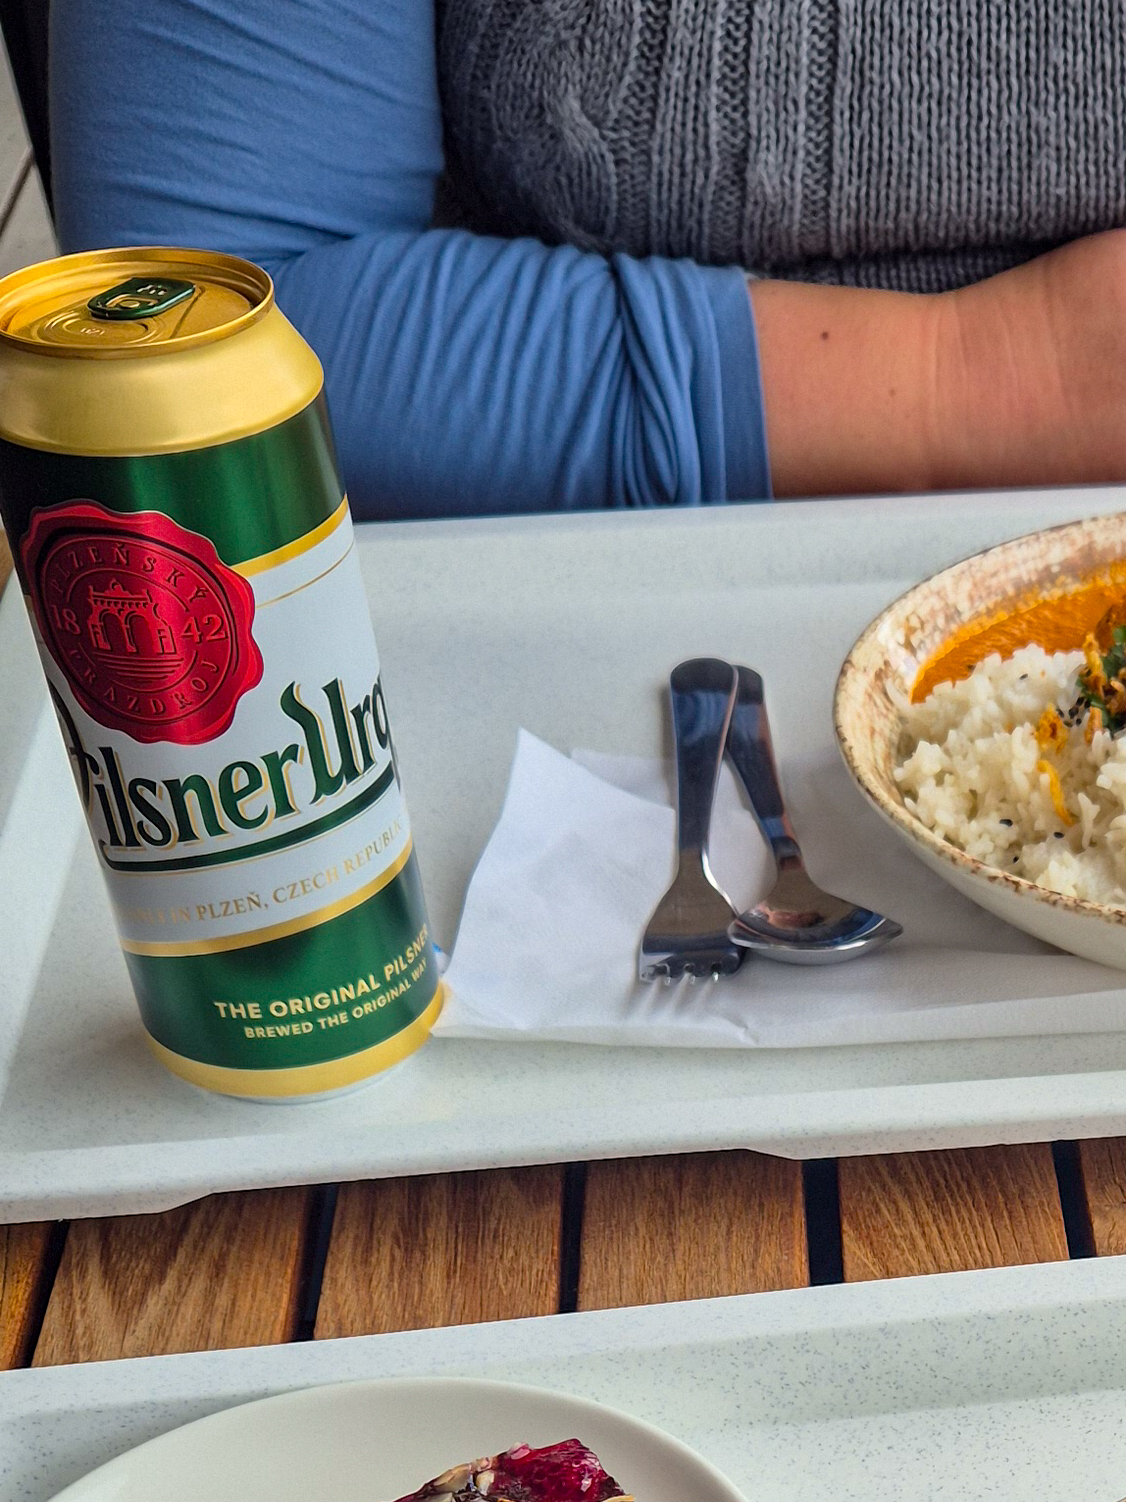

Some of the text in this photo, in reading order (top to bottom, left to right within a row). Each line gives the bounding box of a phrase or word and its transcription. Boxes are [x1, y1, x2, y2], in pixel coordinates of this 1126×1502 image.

[51, 604, 229, 645] 18 42
[272, 864, 340, 904] CZECH
[214, 923, 428, 1020] THE ORIGINAL PILSNER
[244, 957, 427, 1039] BREWED THE ORIGINAL WAY
